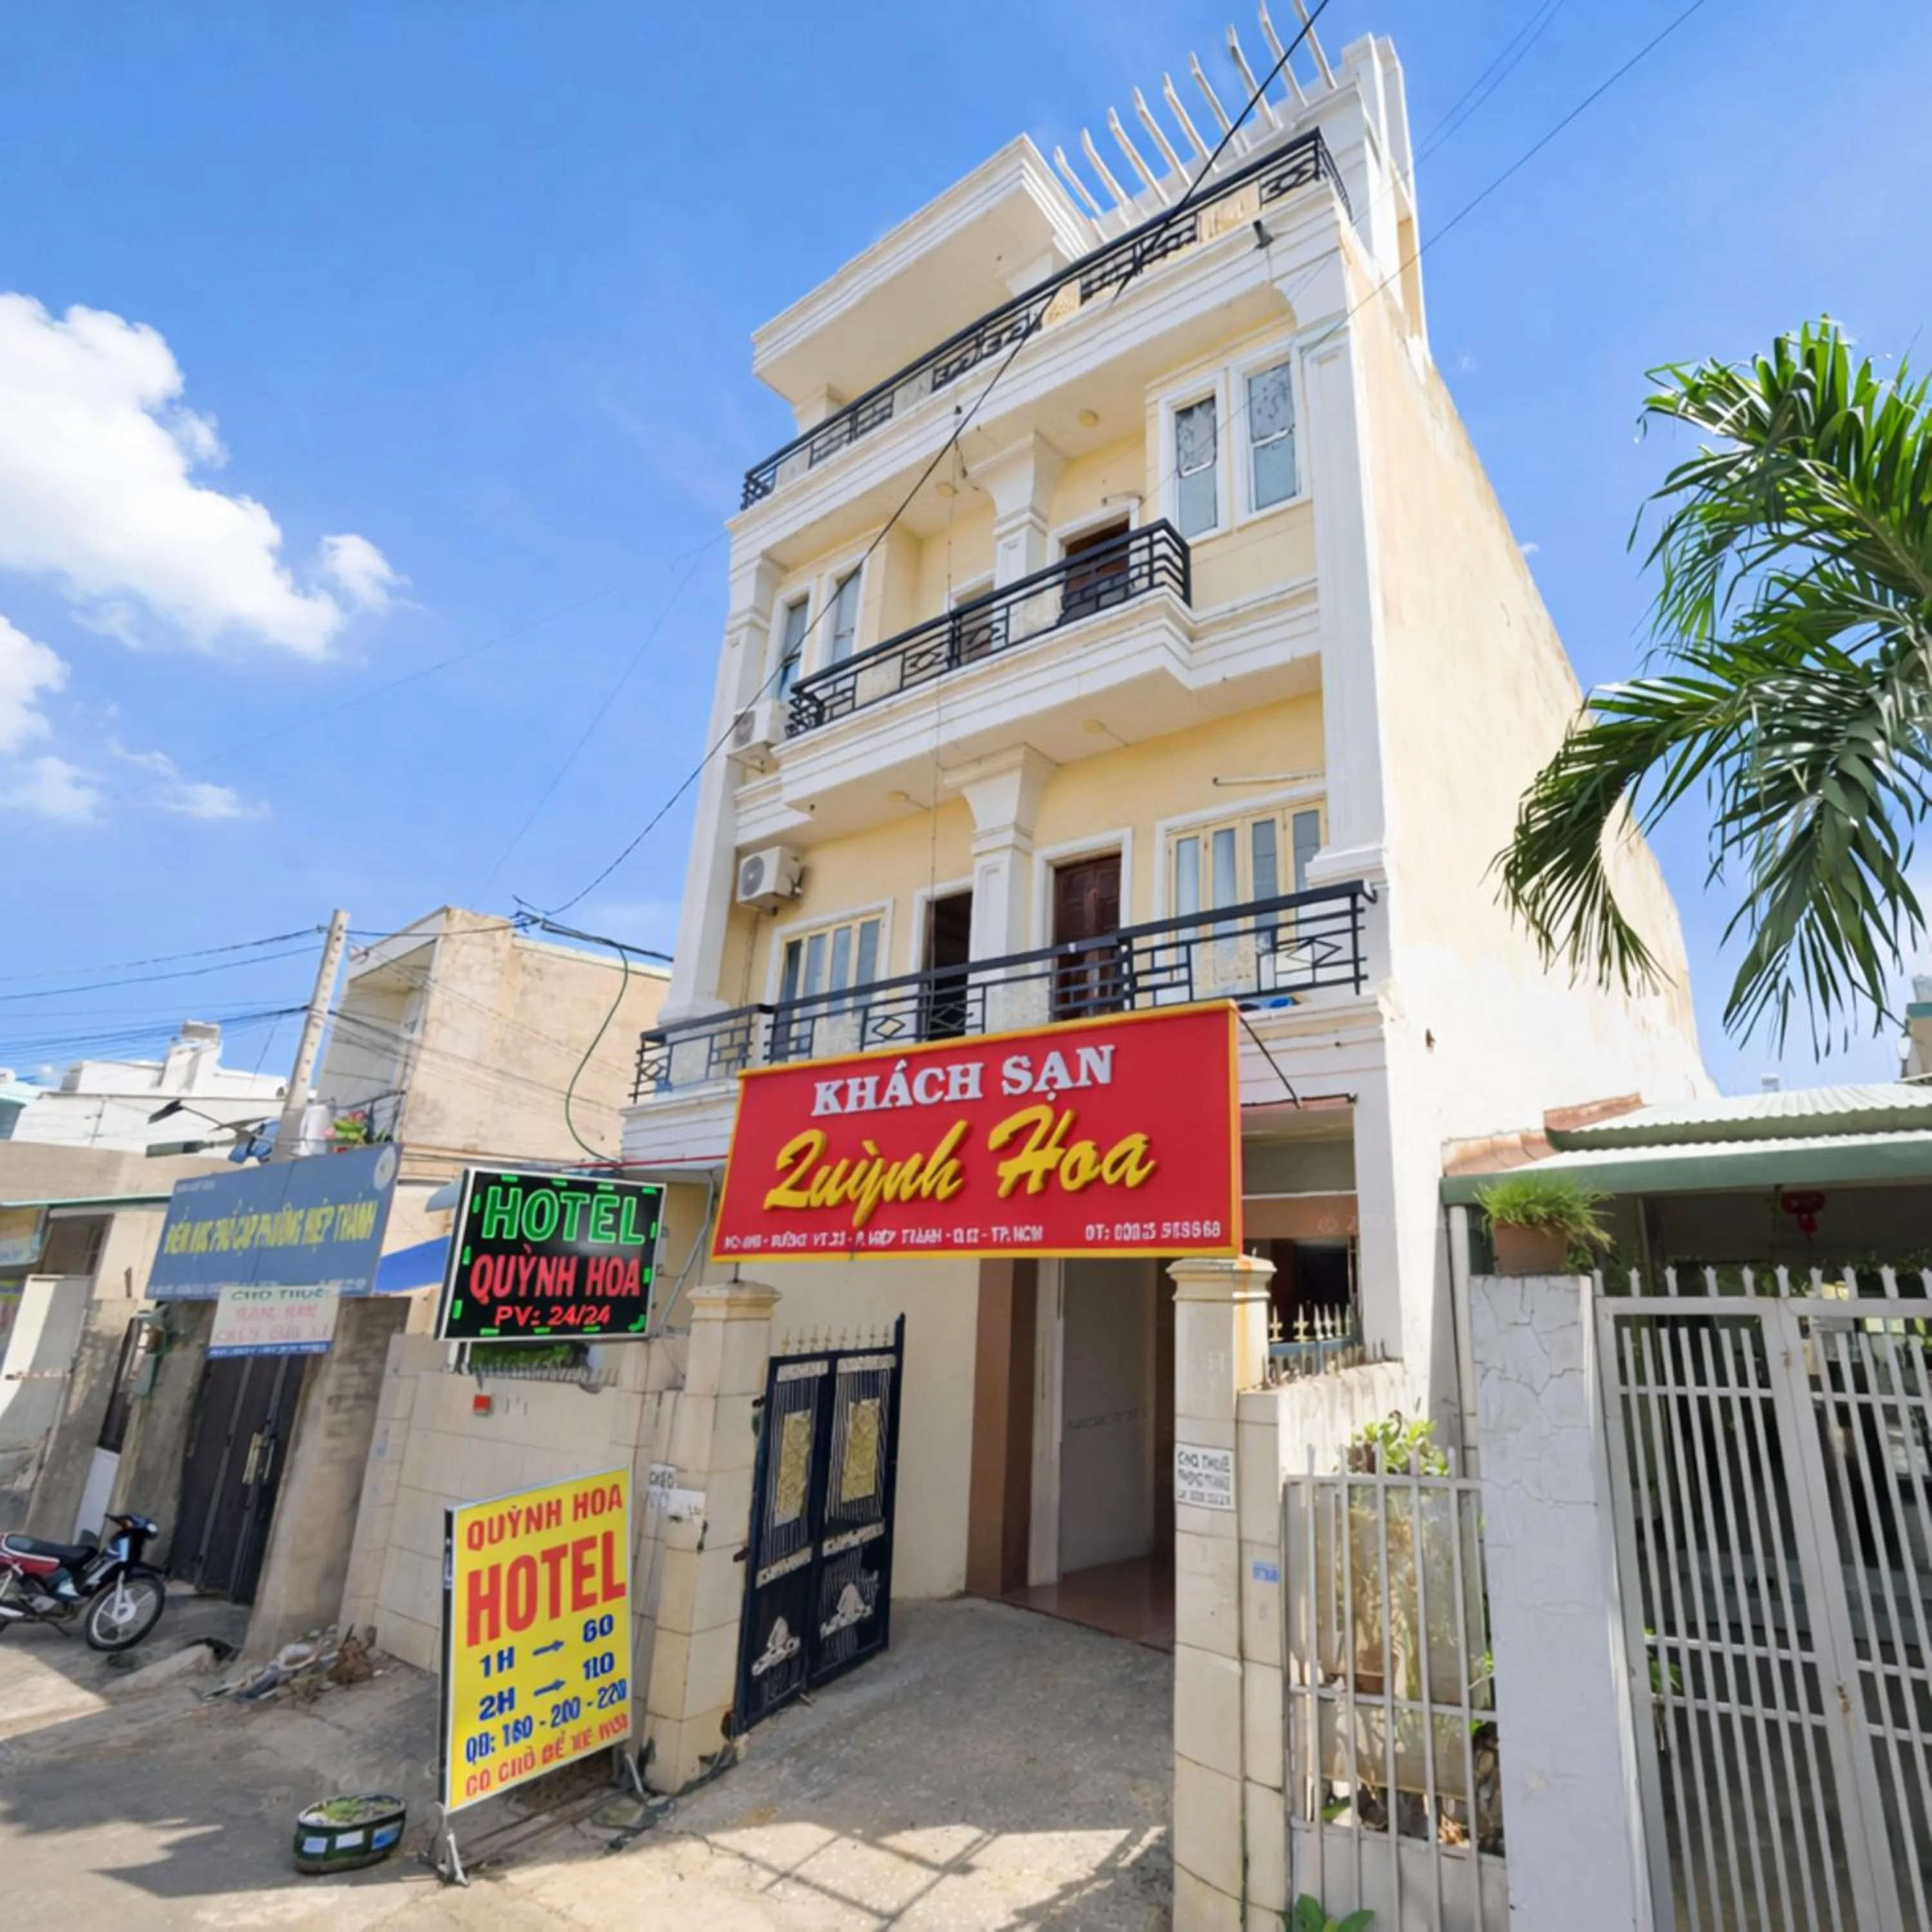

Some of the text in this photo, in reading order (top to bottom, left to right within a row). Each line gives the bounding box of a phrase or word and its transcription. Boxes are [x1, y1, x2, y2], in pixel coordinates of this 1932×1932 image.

[811, 1044, 1115, 1117] KHÁCH SẠN
[762, 1104, 1157, 1227] Quỳnh Hoa
[481, 1186, 645, 1245] HOTEL
[469, 1243, 641, 1305] QUỲNH HOA
[494, 1303, 611, 1328] PV: 24/24
[466, 1483, 623, 1551] QUỲNH HOA
[466, 1530, 627, 1649] HOTEL
[480, 1613, 614, 1678] 1H 60
[479, 1651, 615, 1721] 2H 110
